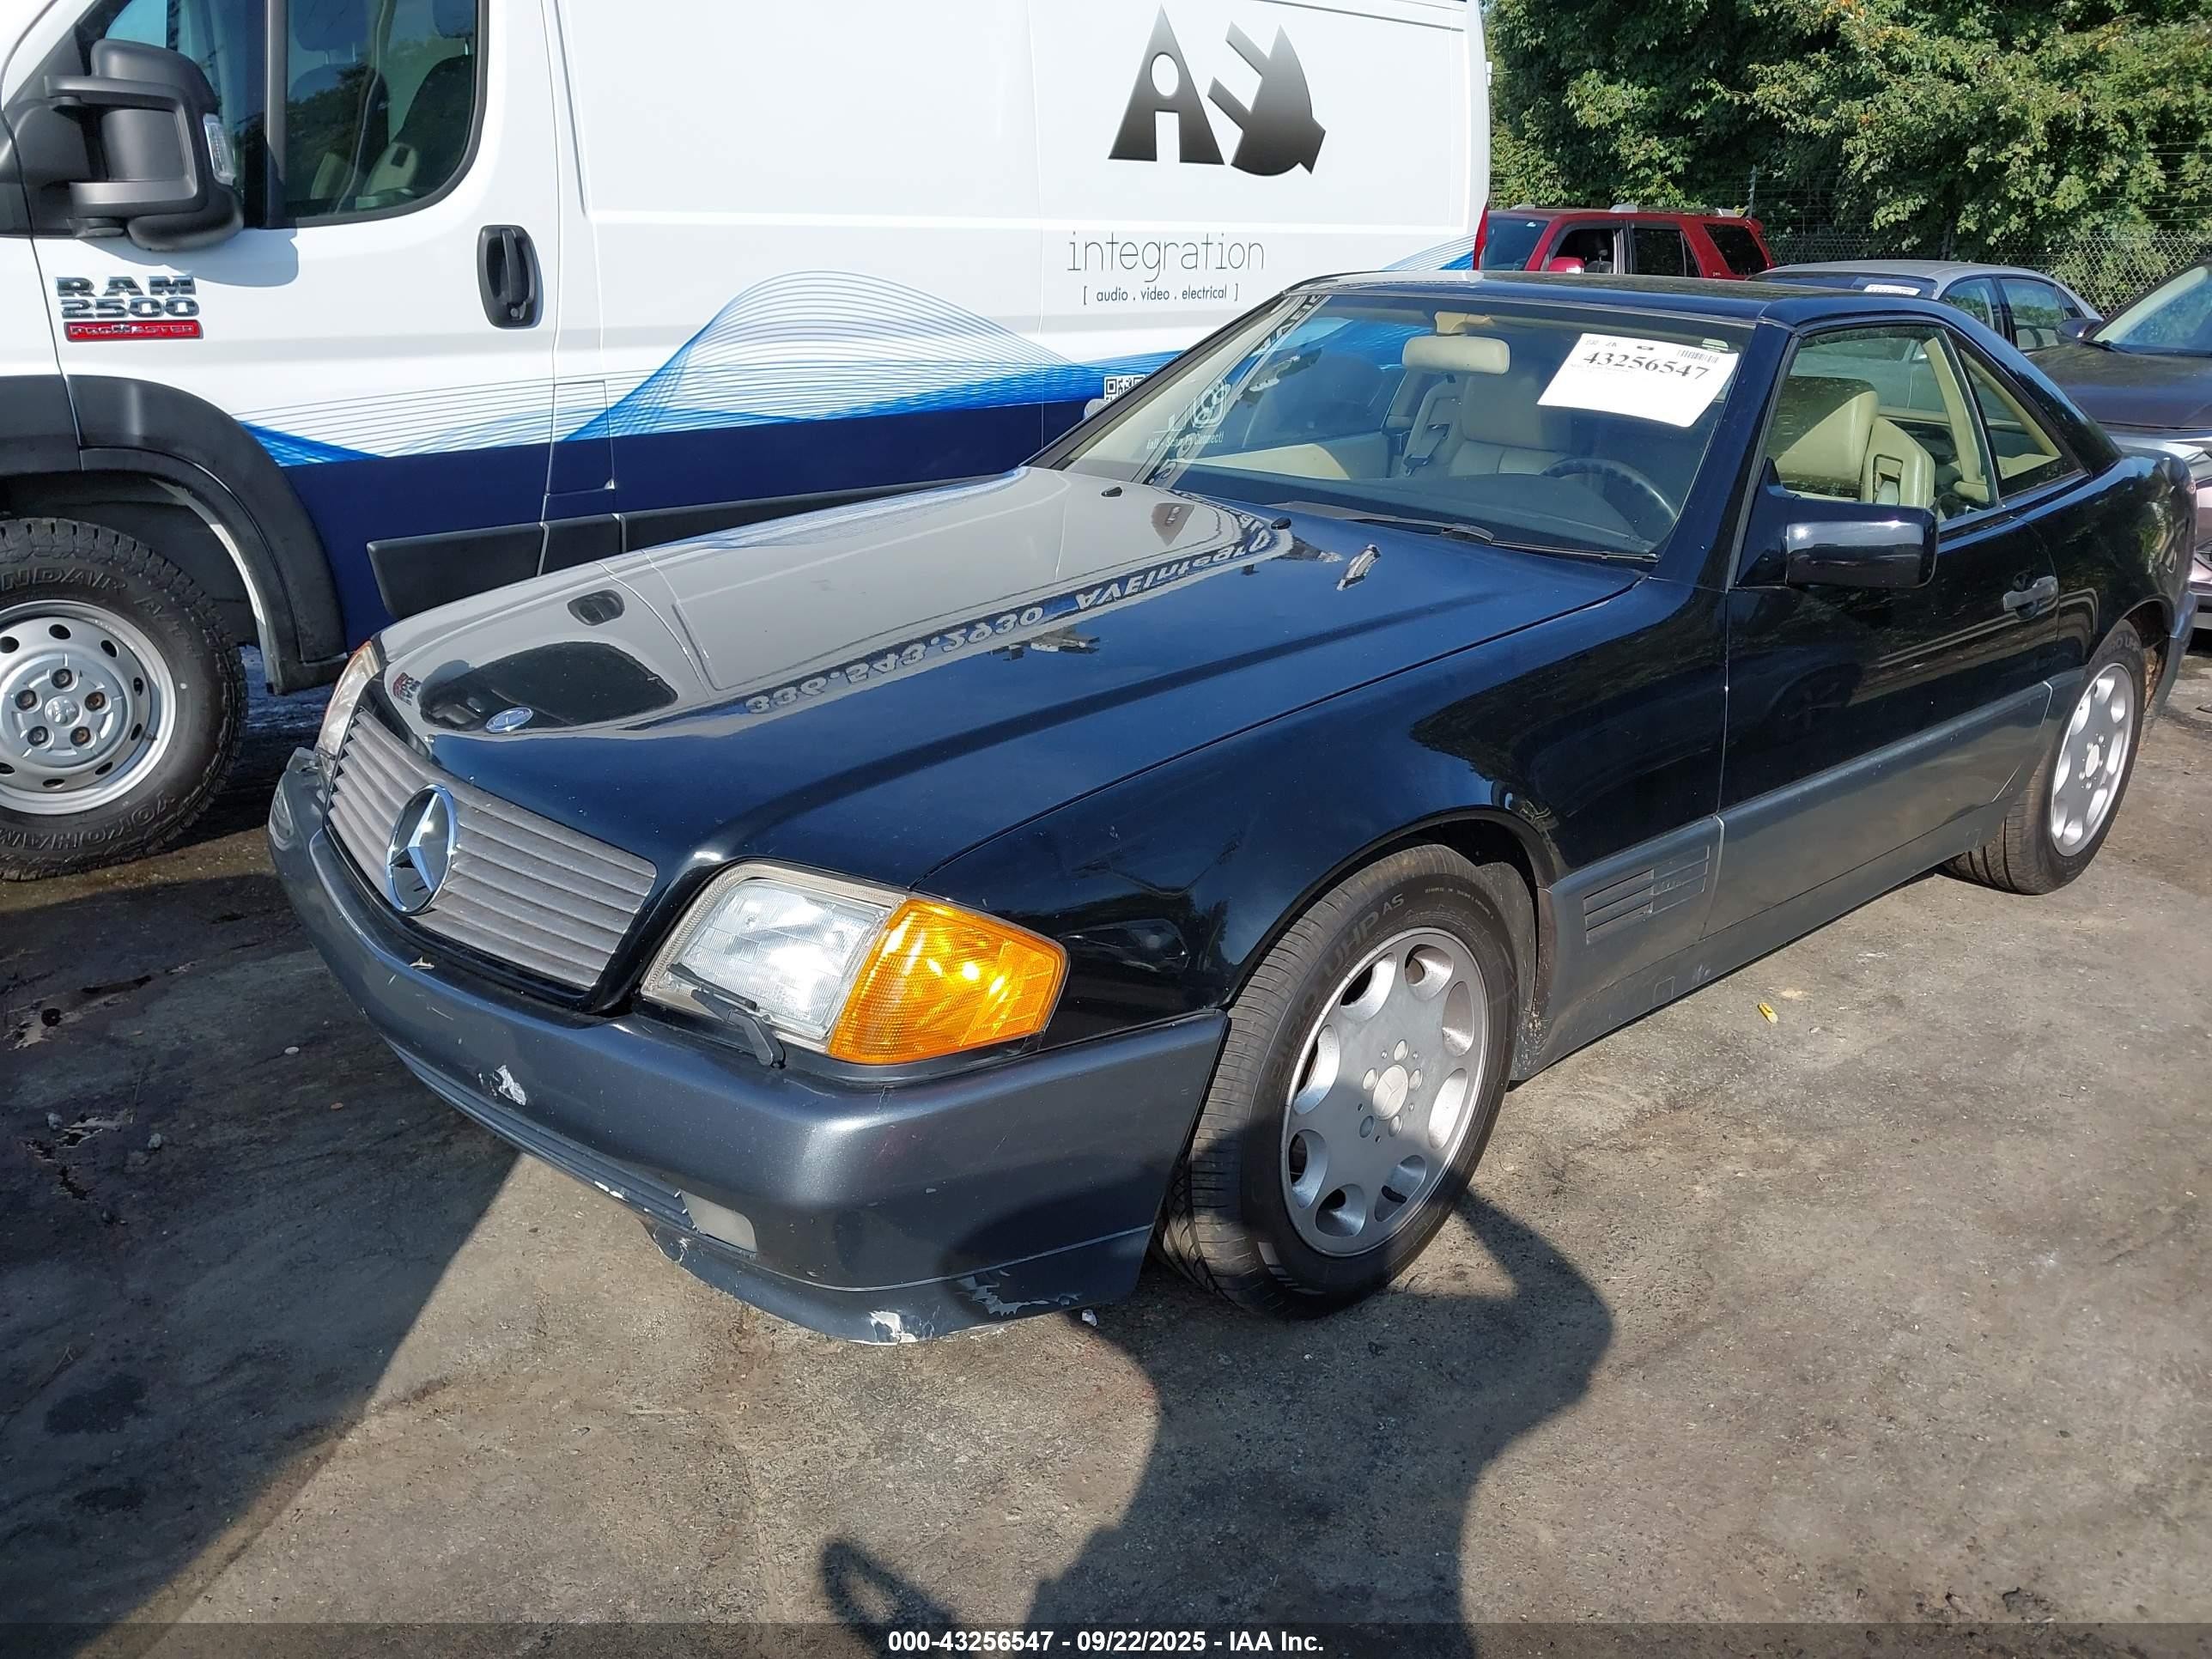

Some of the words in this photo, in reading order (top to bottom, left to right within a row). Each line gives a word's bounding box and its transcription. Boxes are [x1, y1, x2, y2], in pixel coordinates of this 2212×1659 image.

[1067, 231, 1264, 283] integration
[55, 275, 197, 296] RAM
[1097, 287, 1128, 301] audio
[1140, 286, 1170, 301] video
[1182, 285, 1227, 300] electrical
[60, 297, 200, 319] 2500
[1583, 350, 1711, 380] 43256547
